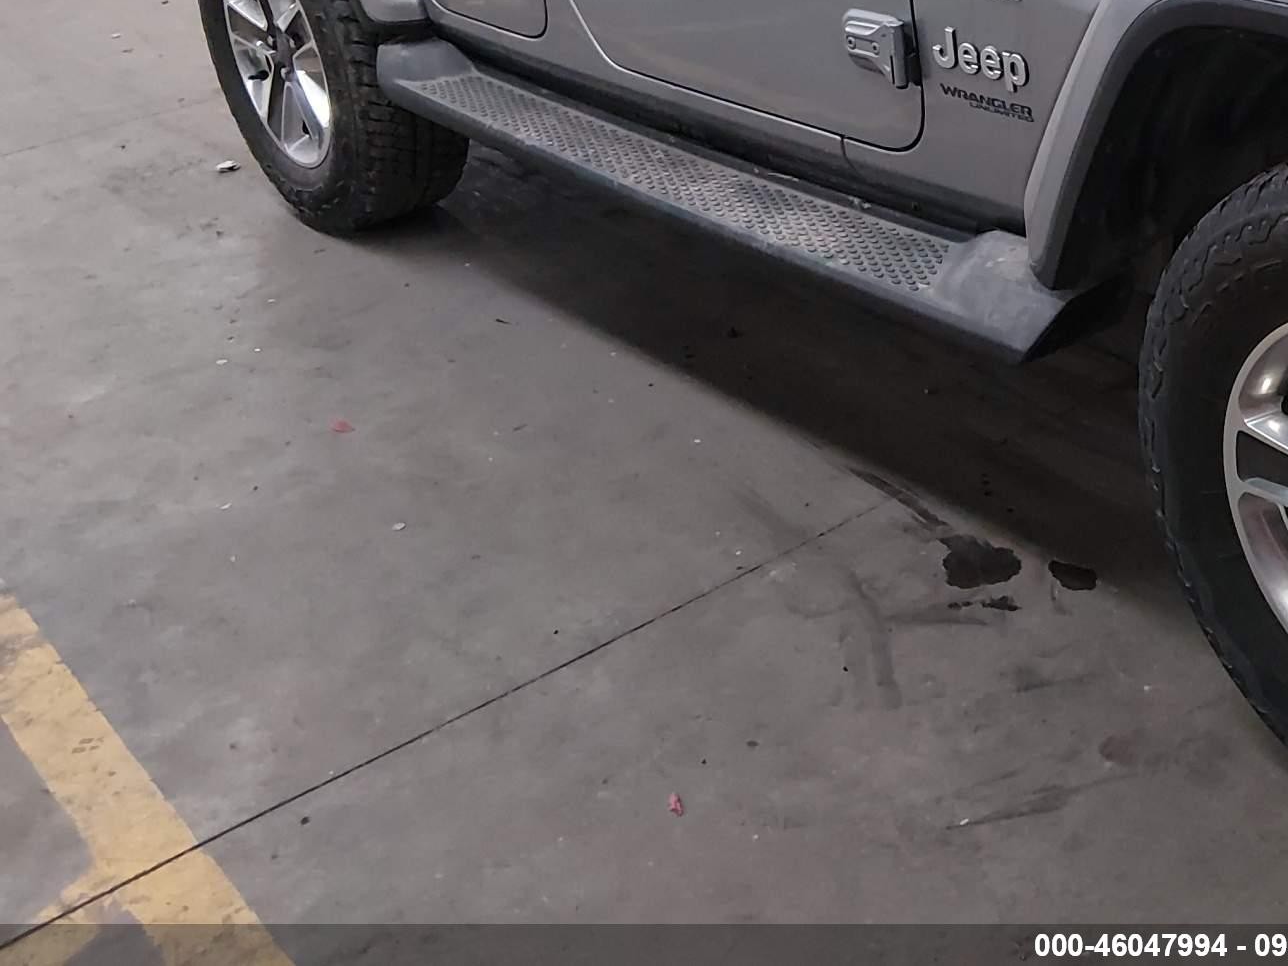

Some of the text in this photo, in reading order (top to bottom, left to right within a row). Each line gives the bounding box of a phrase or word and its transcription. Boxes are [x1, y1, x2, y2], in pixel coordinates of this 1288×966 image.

[932, 26, 1029, 93] Jeep
[940, 83, 1033, 116] WRANGLER
[969, 101, 1035, 122] UNLIMITED
